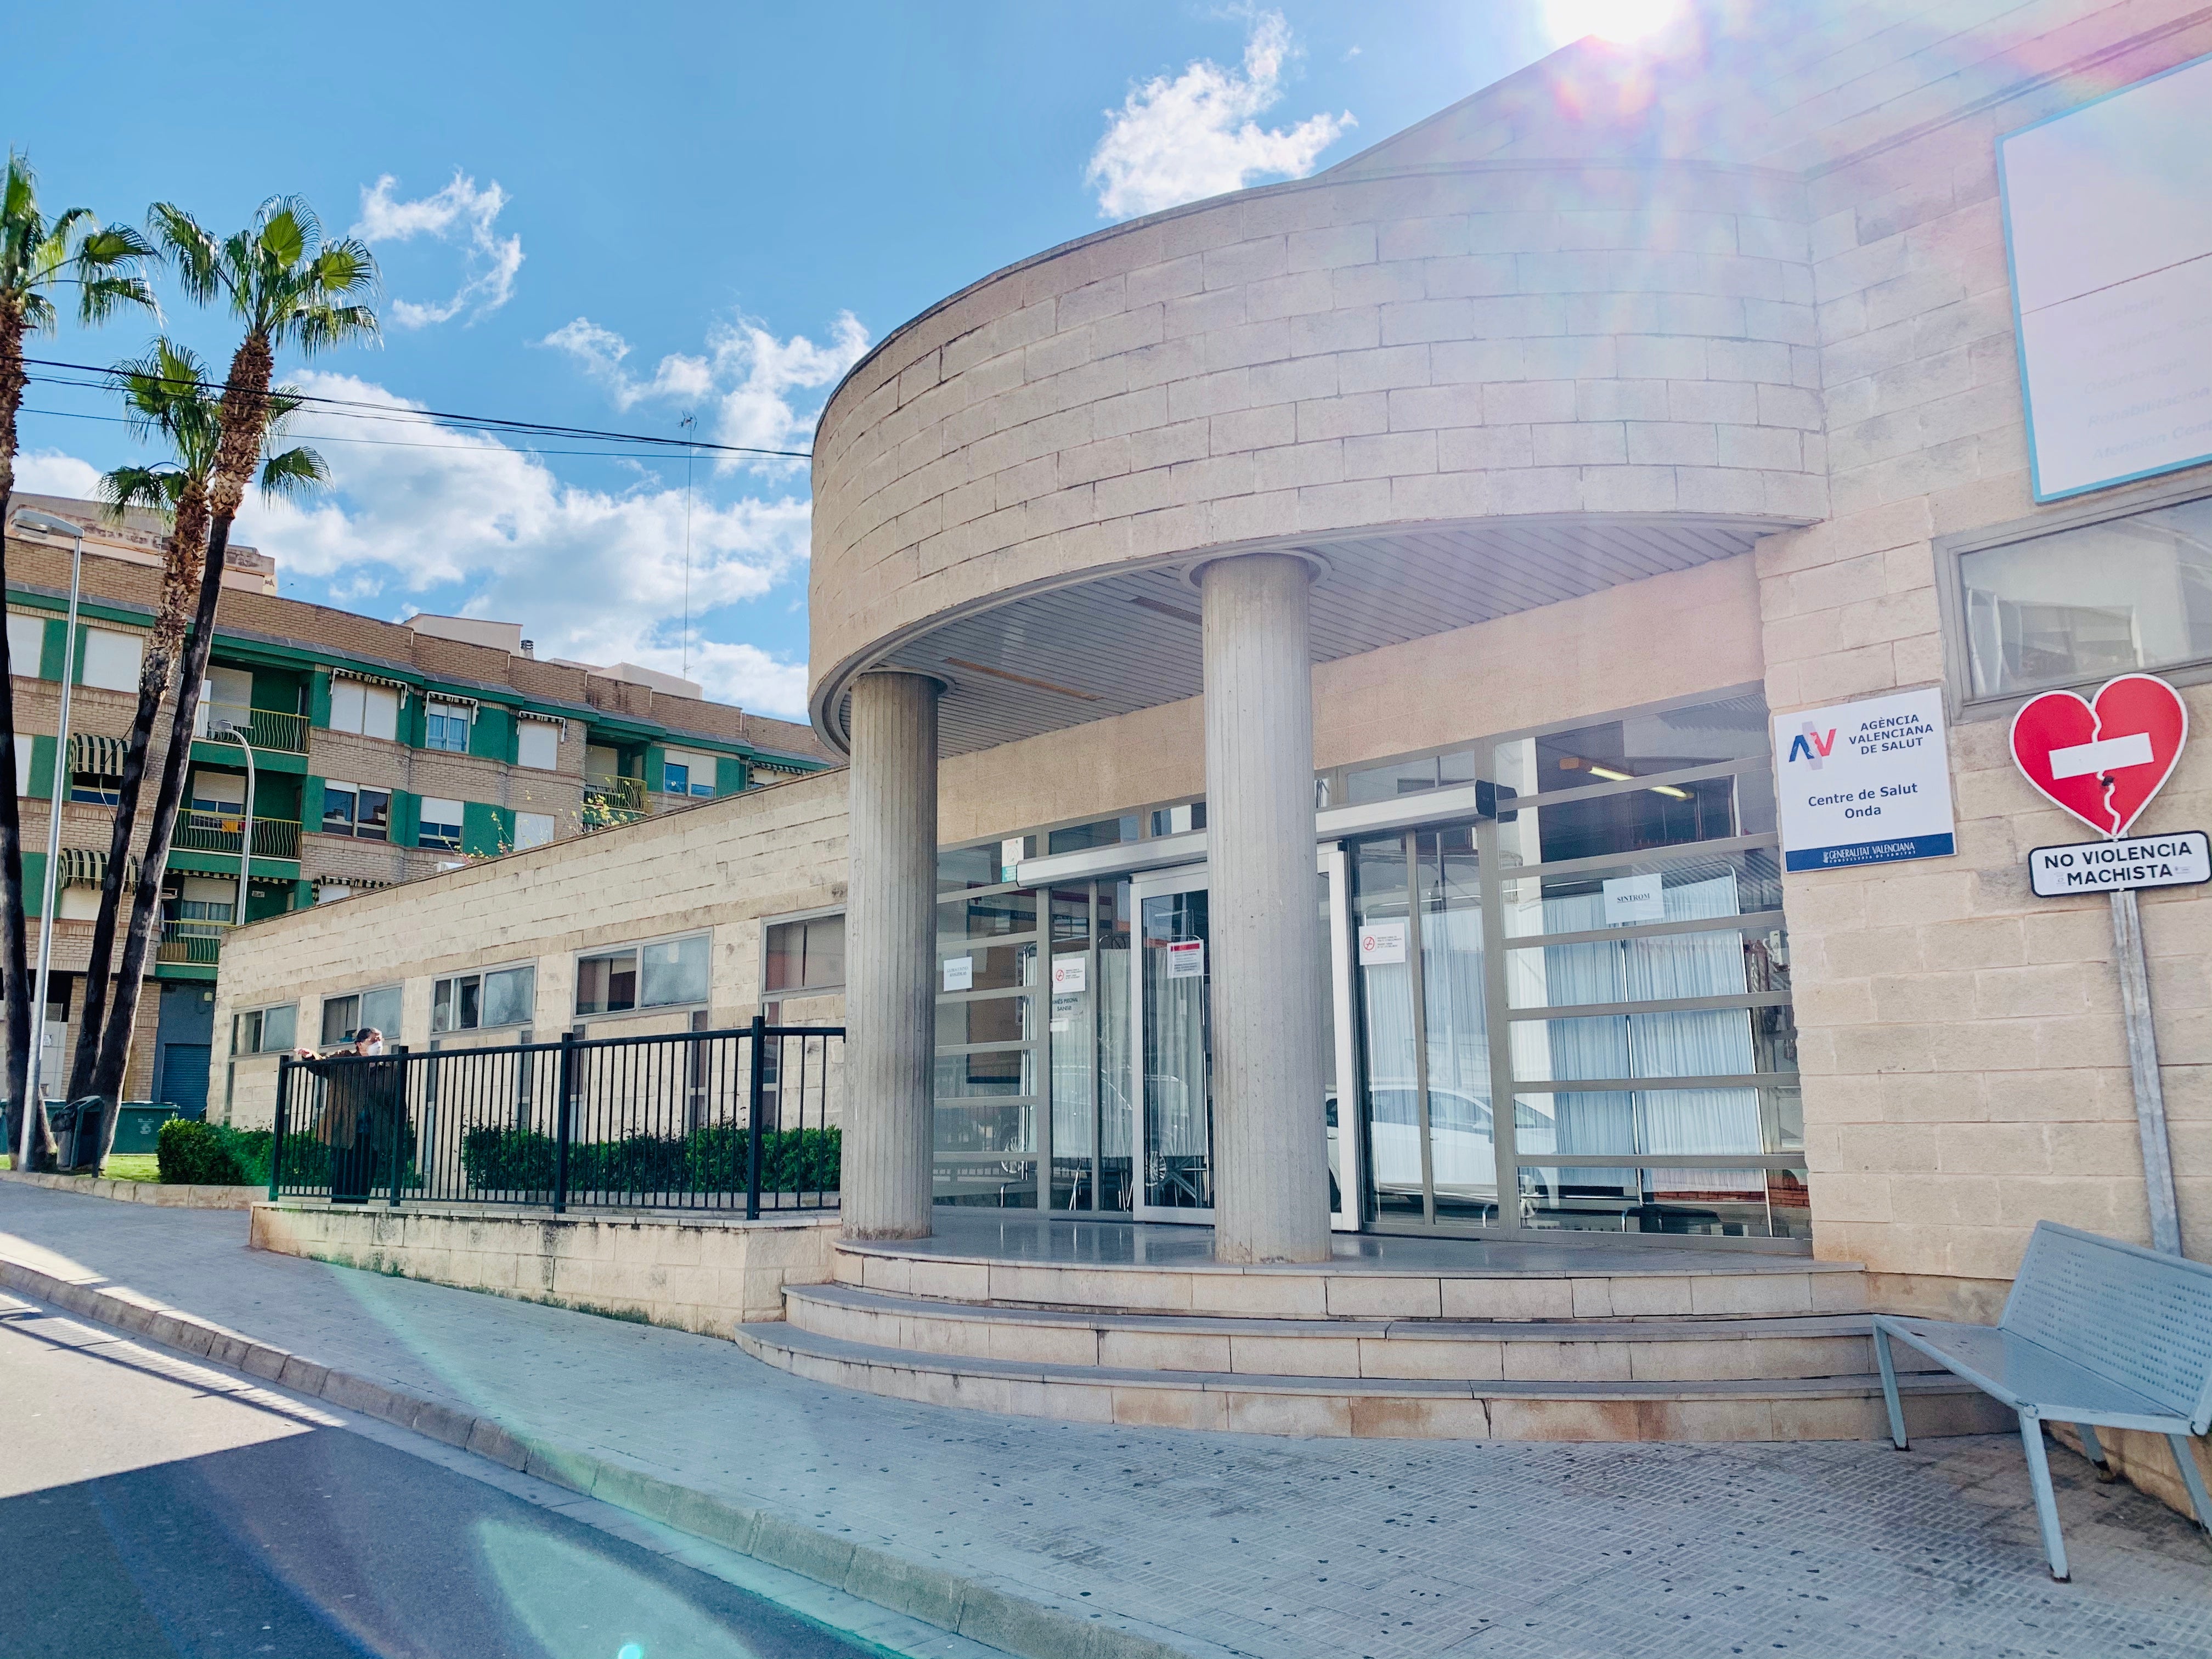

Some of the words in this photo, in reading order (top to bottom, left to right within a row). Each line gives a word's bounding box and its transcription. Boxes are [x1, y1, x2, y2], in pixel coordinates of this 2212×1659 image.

[1861, 714, 1919, 731] AGÈNCIA
[1849, 724, 1933, 744] VALENCIANA
[1861, 744, 1877, 755] DE
[1882, 737, 1923, 752] SALUT
[1808, 793, 1854, 806] Centre
[1858, 789, 1875, 800] de
[1880, 783, 1918, 797] Salut
[1845, 805, 1881, 819] Onda
[1829, 847, 1870, 860] GENERALITAT
[1872, 842, 1915, 855] VALENCIANA
[2045, 854, 2074, 869] NO
[2083, 842, 2193, 865] VIOLENCIA
[2067, 864, 2172, 886] MACHISTA
[1617, 893, 1650, 902] SINTROM
